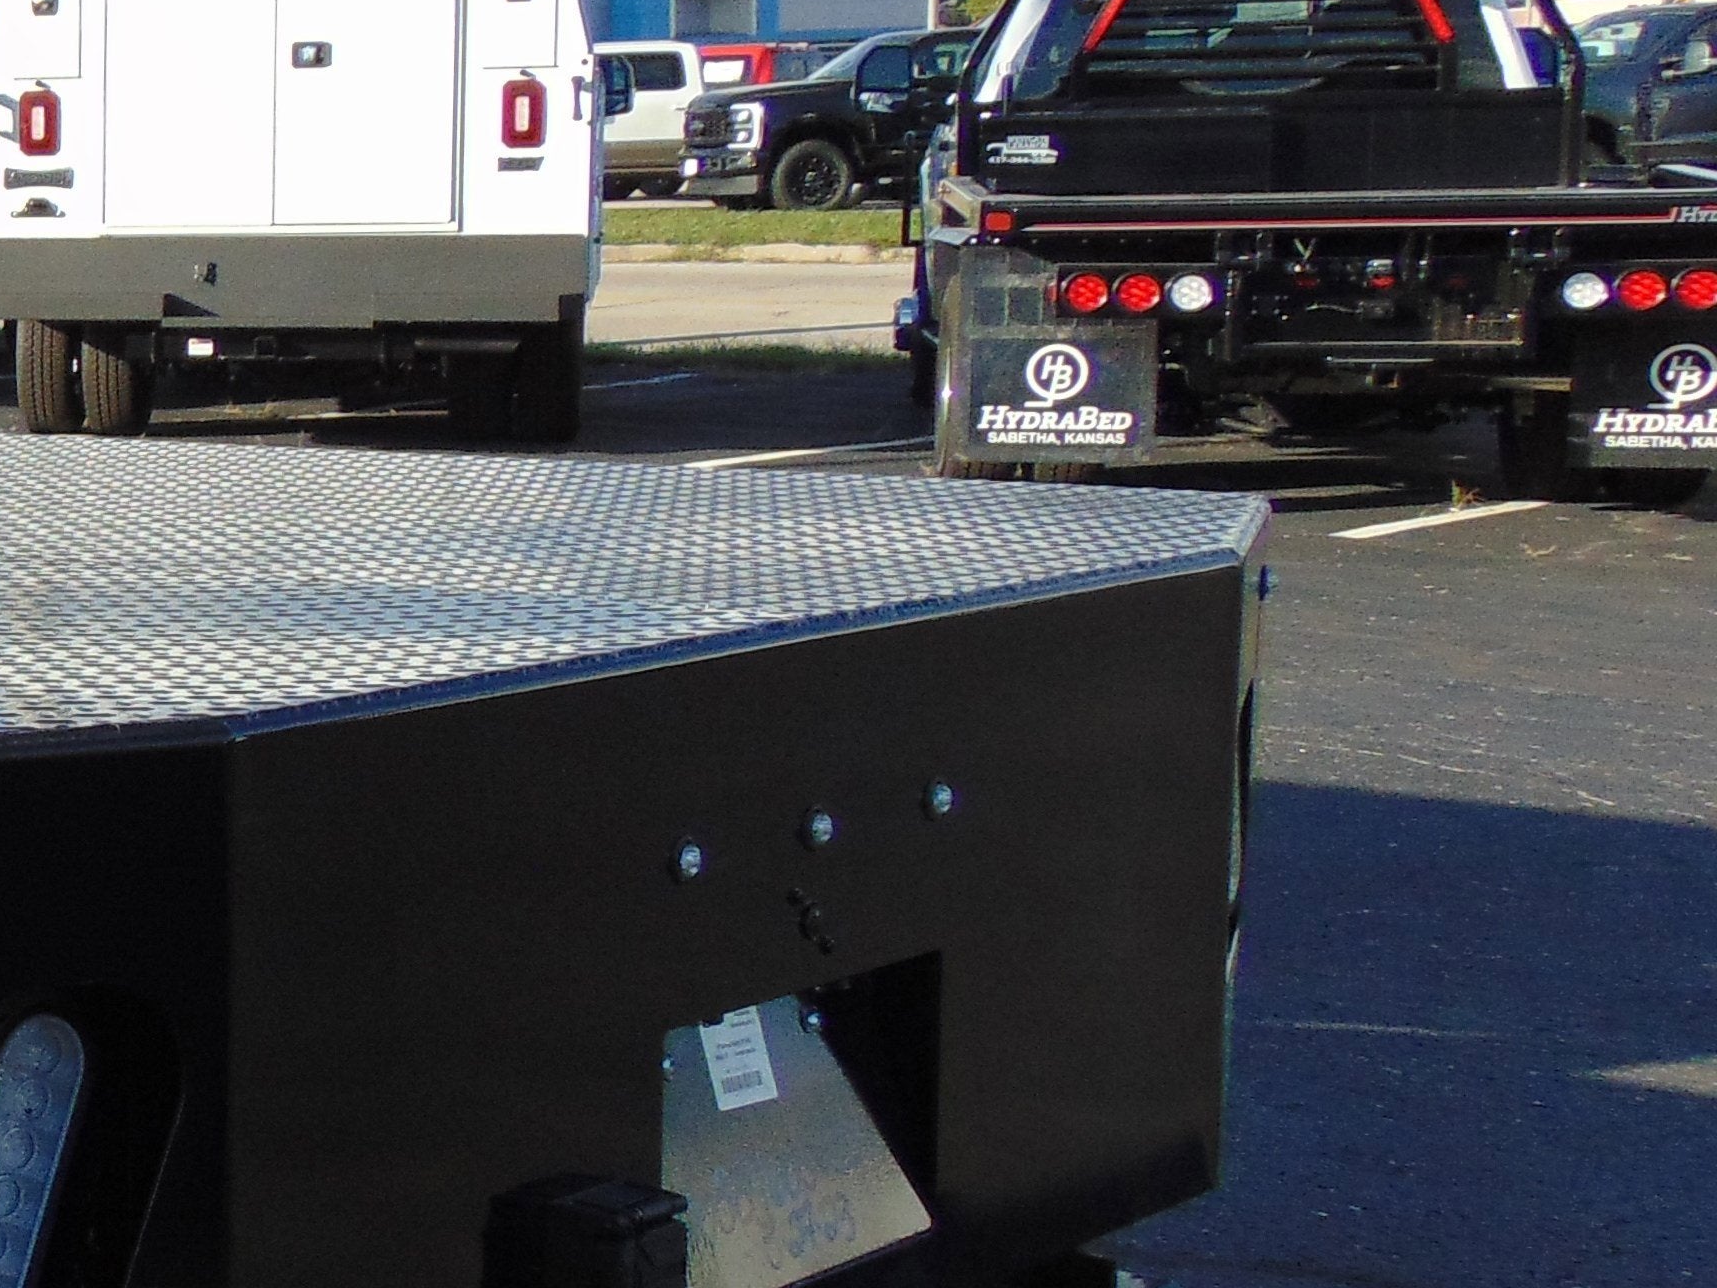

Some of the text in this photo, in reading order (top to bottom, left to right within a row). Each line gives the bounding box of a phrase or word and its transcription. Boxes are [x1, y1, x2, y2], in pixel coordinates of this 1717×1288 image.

[987, 431, 1126, 445] SABETHA, KANSAS
[1604, 434, 1688, 450] SABETHA,
